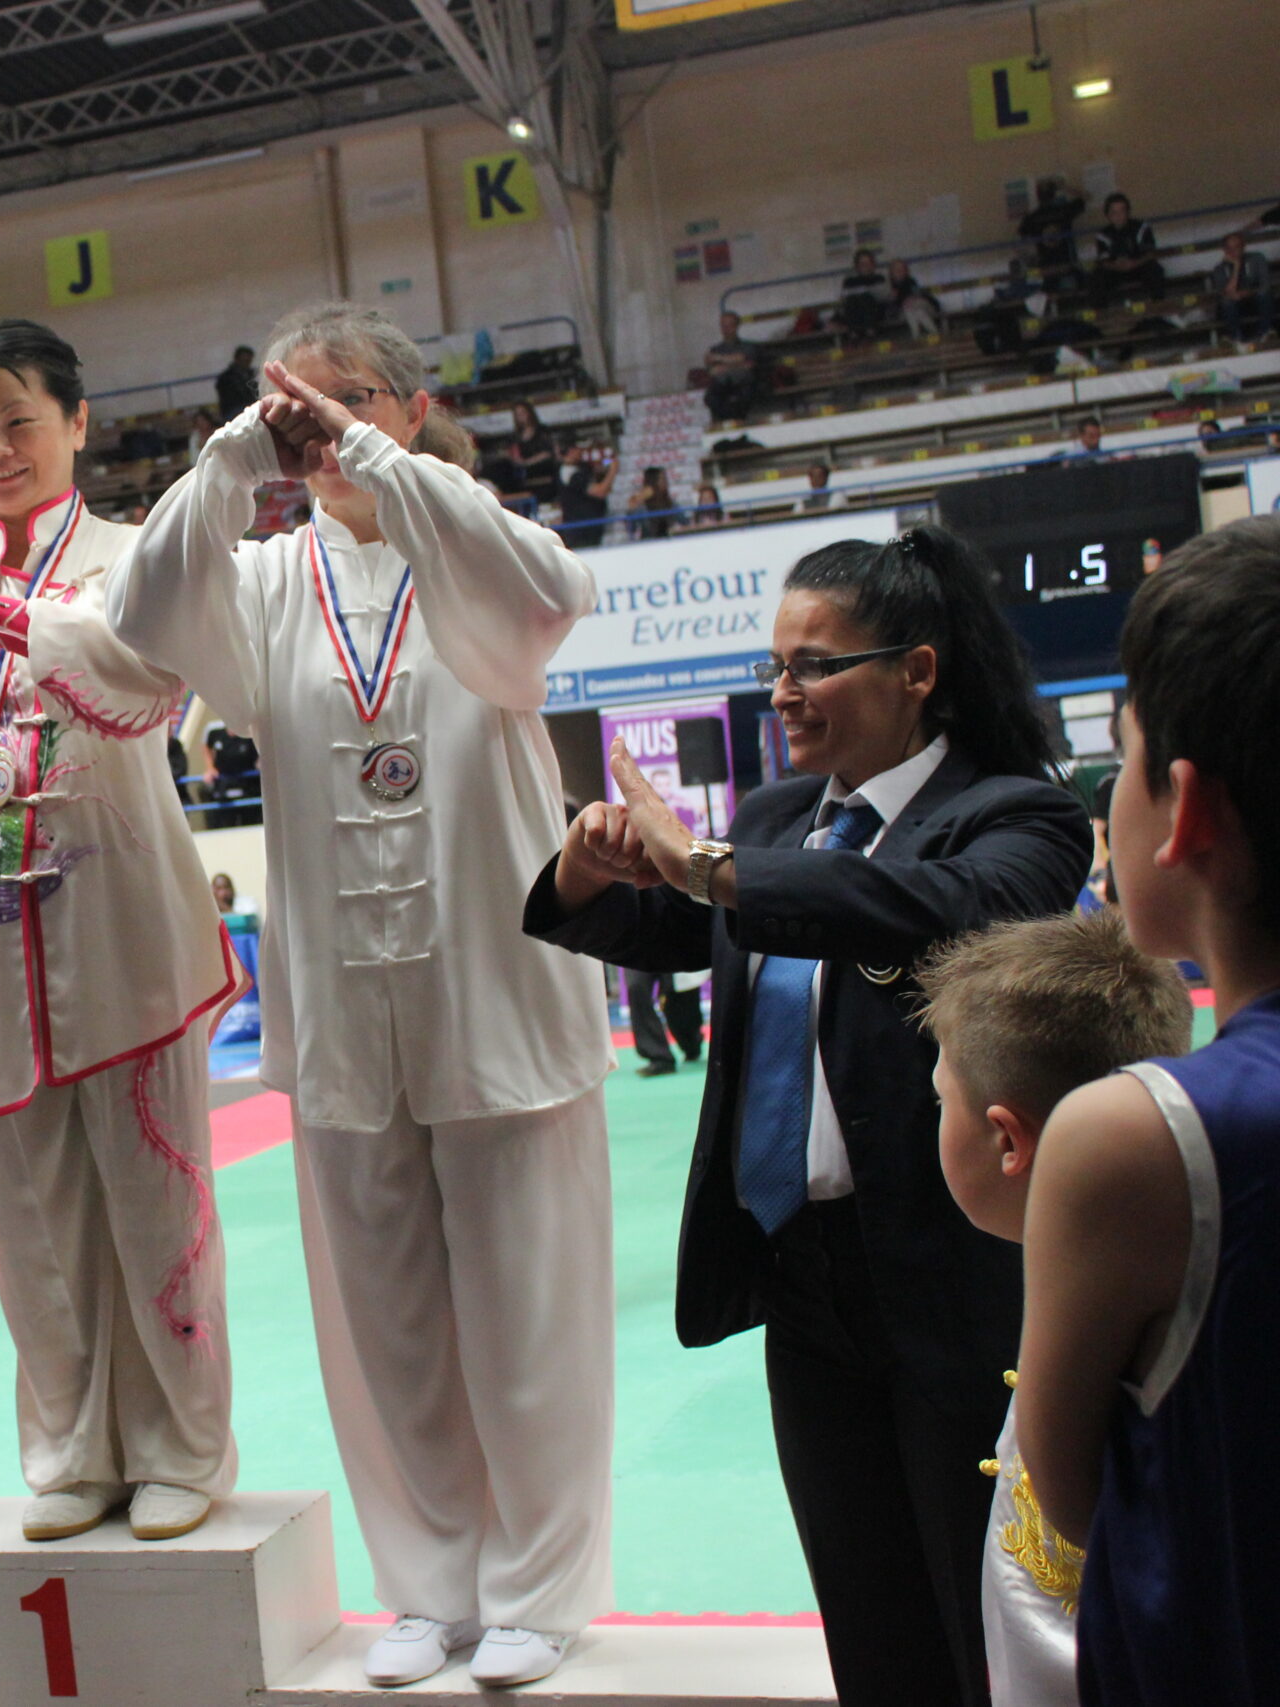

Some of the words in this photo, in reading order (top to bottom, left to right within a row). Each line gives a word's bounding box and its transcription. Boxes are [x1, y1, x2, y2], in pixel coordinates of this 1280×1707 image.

[993, 68, 1030, 128] L
[476, 158, 525, 219] K
[68, 241, 92, 294] J
[592, 566, 767, 615] rrefour
[631, 608, 761, 646] Evreux
[614, 718, 678, 759] WUS
[19, 1577, 78, 1697] 1
